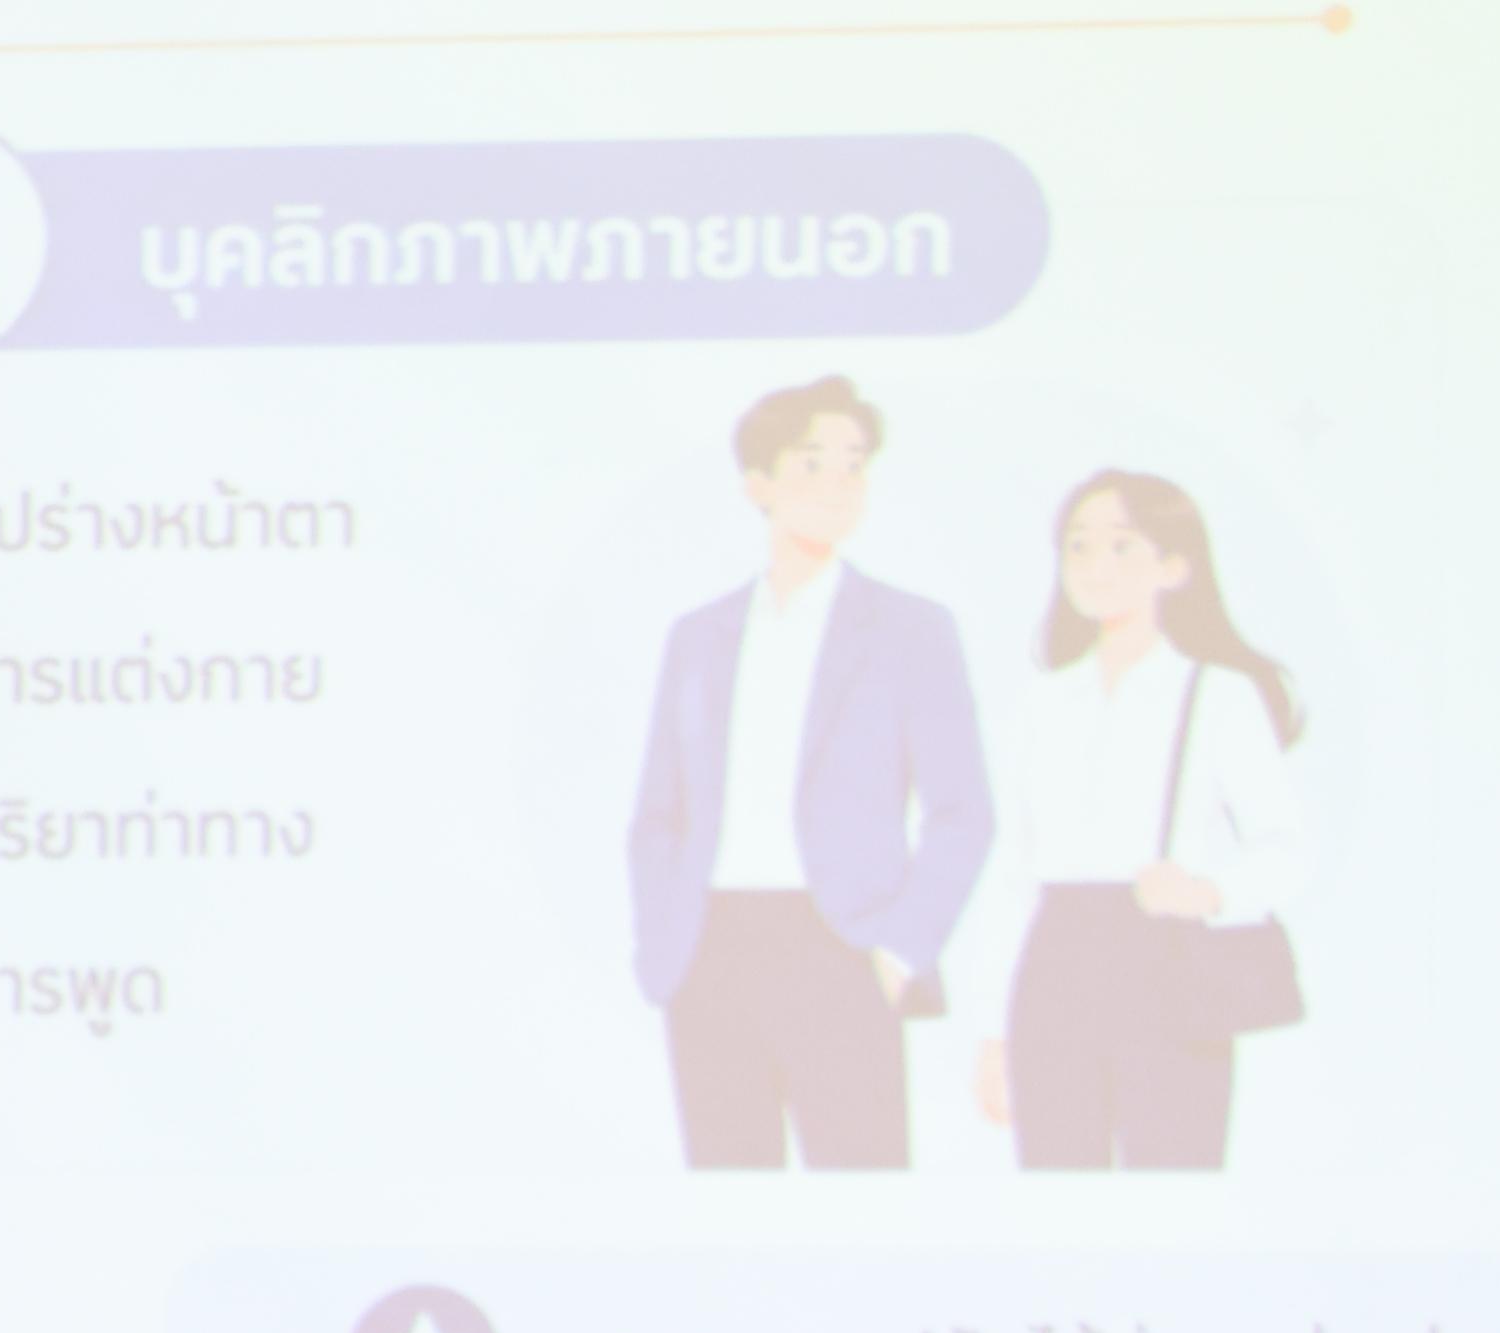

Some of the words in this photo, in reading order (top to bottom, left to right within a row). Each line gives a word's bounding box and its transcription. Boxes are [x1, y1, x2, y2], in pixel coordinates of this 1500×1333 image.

[141, 204, 952, 320] บุคลิกภาพภายนอก
